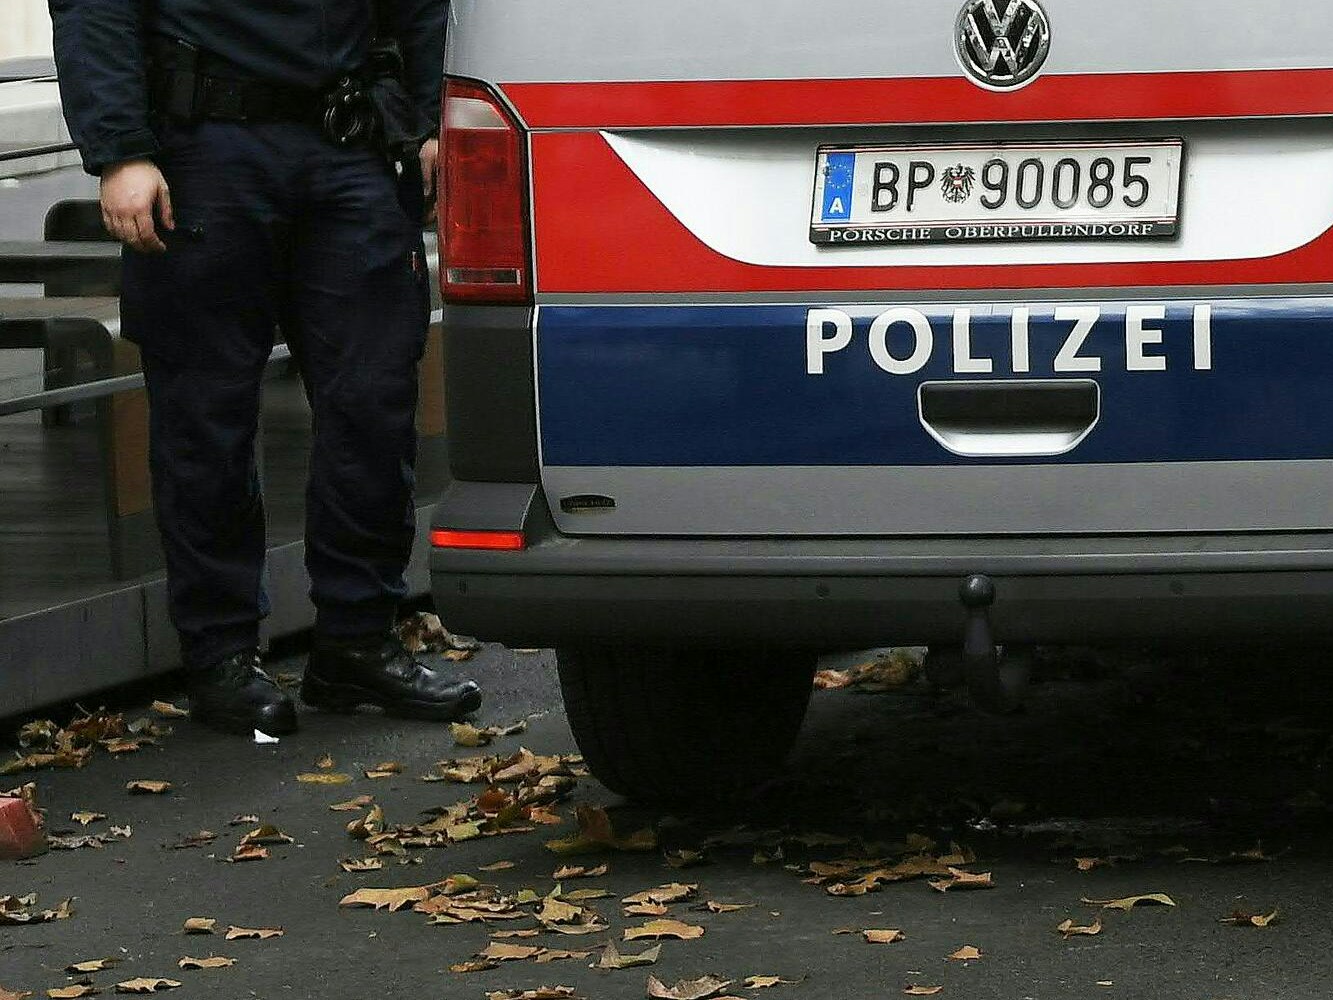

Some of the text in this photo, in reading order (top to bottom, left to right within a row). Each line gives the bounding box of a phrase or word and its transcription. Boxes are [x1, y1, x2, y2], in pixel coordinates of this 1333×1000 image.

[871, 156, 1152, 213] BP 90085
[828, 198, 844, 214] A
[829, 223, 1154, 242] PORSCHE OBERPULLENDORF
[806, 304, 1212, 375] POLIZEI
